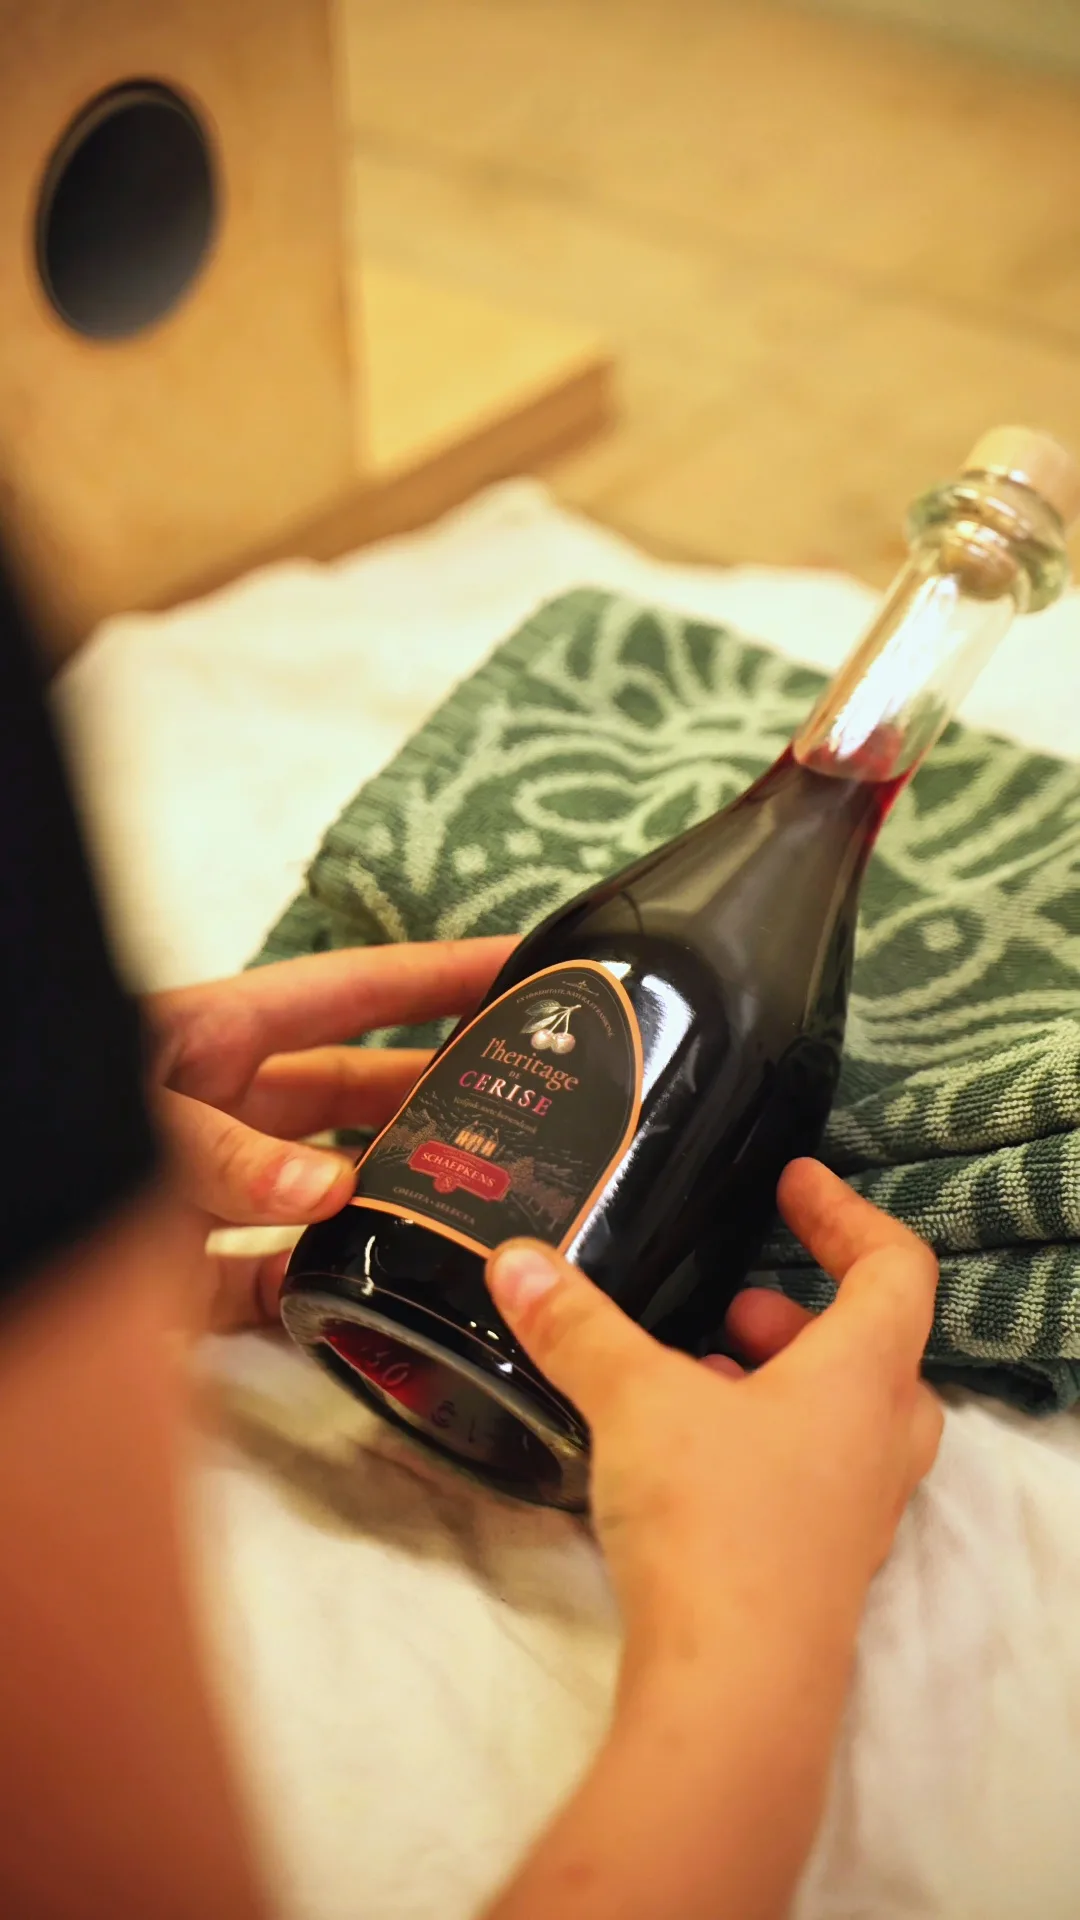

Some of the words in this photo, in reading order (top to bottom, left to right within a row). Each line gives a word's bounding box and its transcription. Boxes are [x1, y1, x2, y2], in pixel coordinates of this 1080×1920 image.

[459, 1070, 552, 1116] CERISE
[508, 1070, 522, 1080] DE
[421, 1152, 496, 1188] SCHAEPKENS
